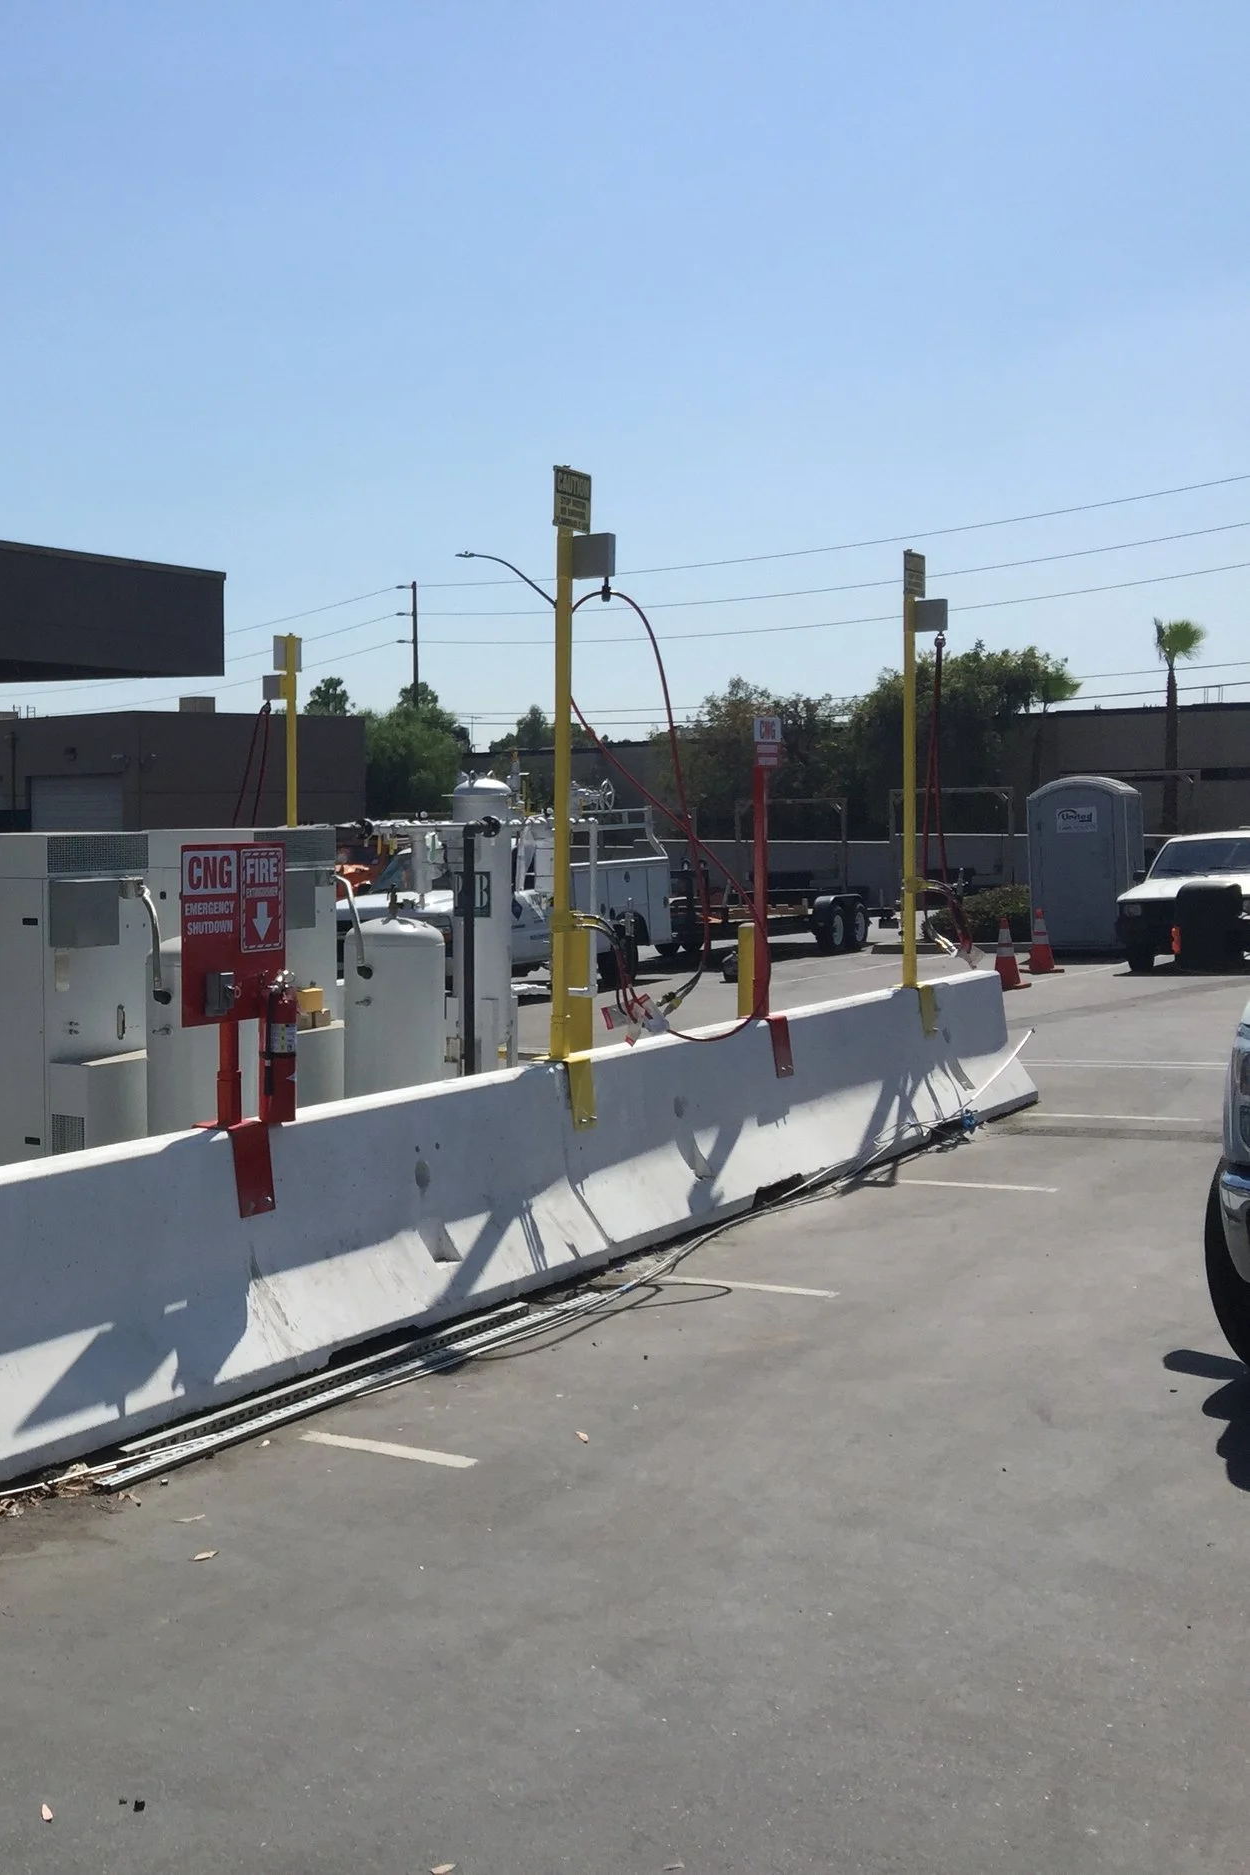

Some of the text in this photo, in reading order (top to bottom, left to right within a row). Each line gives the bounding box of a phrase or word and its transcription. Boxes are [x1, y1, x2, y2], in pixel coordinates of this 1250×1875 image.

[188, 855, 232, 890] CNG
[246, 857, 278, 884] FIRE
[454, 874, 488, 907] PB
[185, 901, 235, 916] EMERGENCY
[187, 920, 233, 935] SHUTDOWN
